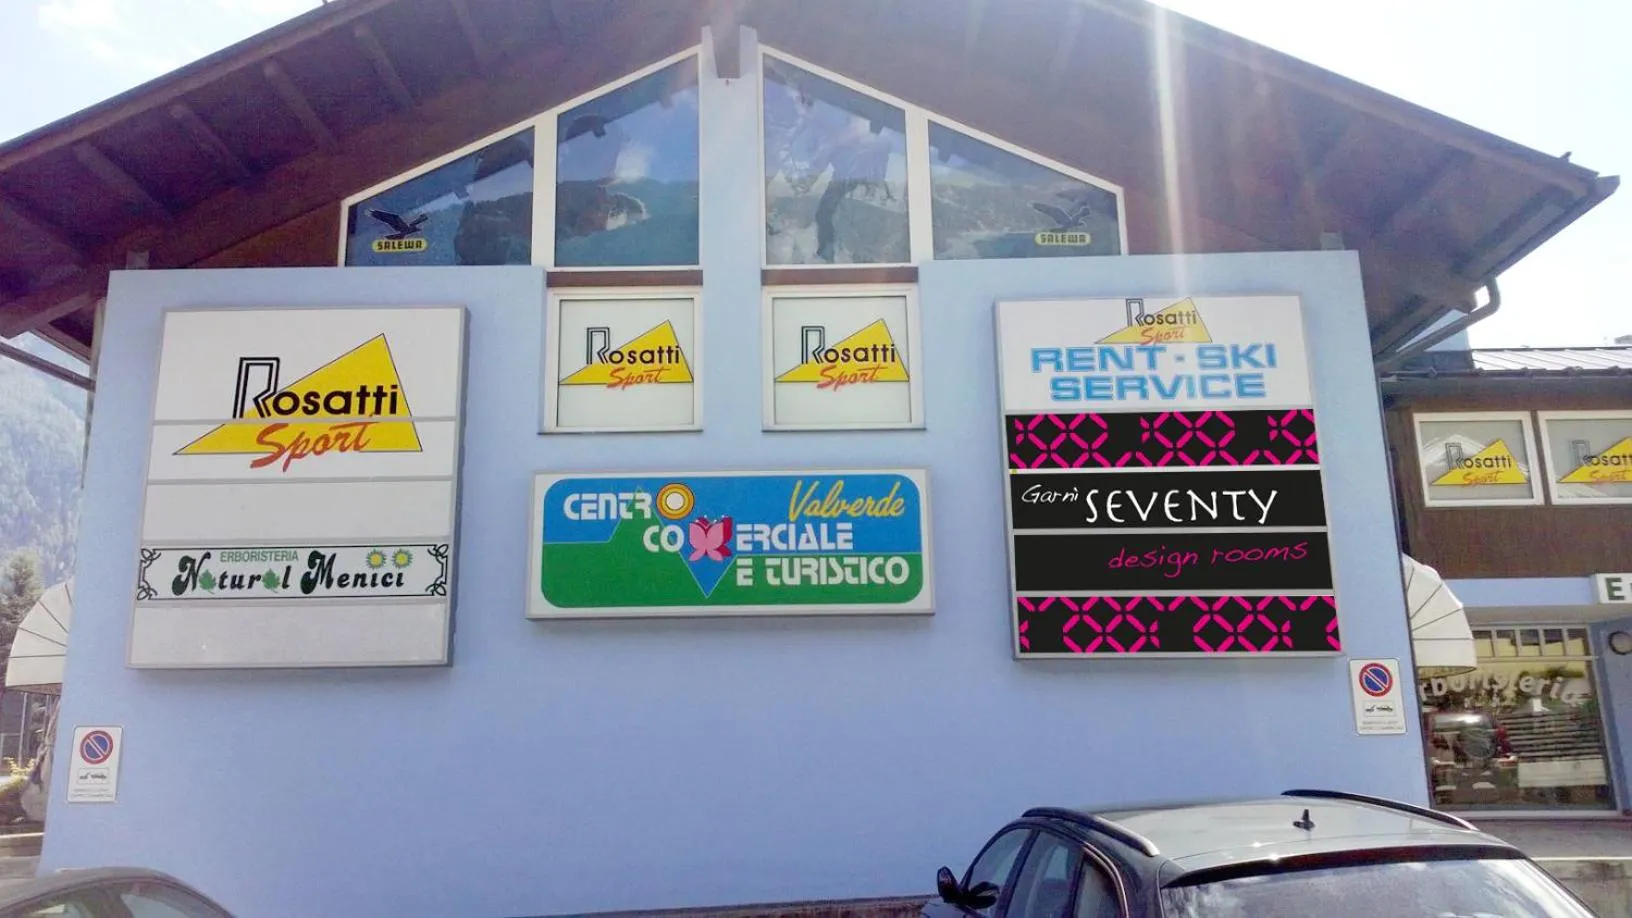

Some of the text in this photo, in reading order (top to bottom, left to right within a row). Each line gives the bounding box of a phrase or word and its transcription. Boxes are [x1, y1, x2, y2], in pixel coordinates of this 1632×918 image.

[376, 240, 423, 251] SALEWA
[1039, 233, 1087, 244] SALEWA
[1125, 298, 1197, 327] Rosatti
[586, 326, 681, 365] Rosatti
[801, 325, 896, 365] Rosatti
[1031, 345, 1167, 373] RENT
[1196, 343, 1278, 369] SKI
[232, 356, 398, 418] Rosatti
[606, 366, 670, 391] Sport
[817, 364, 888, 390] Sport
[1049, 373, 1266, 401] SERVICE
[250, 418, 380, 473] Sport
[1445, 442, 1512, 469] Rosatti
[788, 481, 905, 522] Valverde
[1085, 489, 1278, 524] SEVENTY
[220, 549, 299, 563] ERBORISTERIA
[1108, 541, 1308, 578] design rooms
[300, 550, 404, 595] Menici
[736, 557, 909, 585] E TURISTICO
